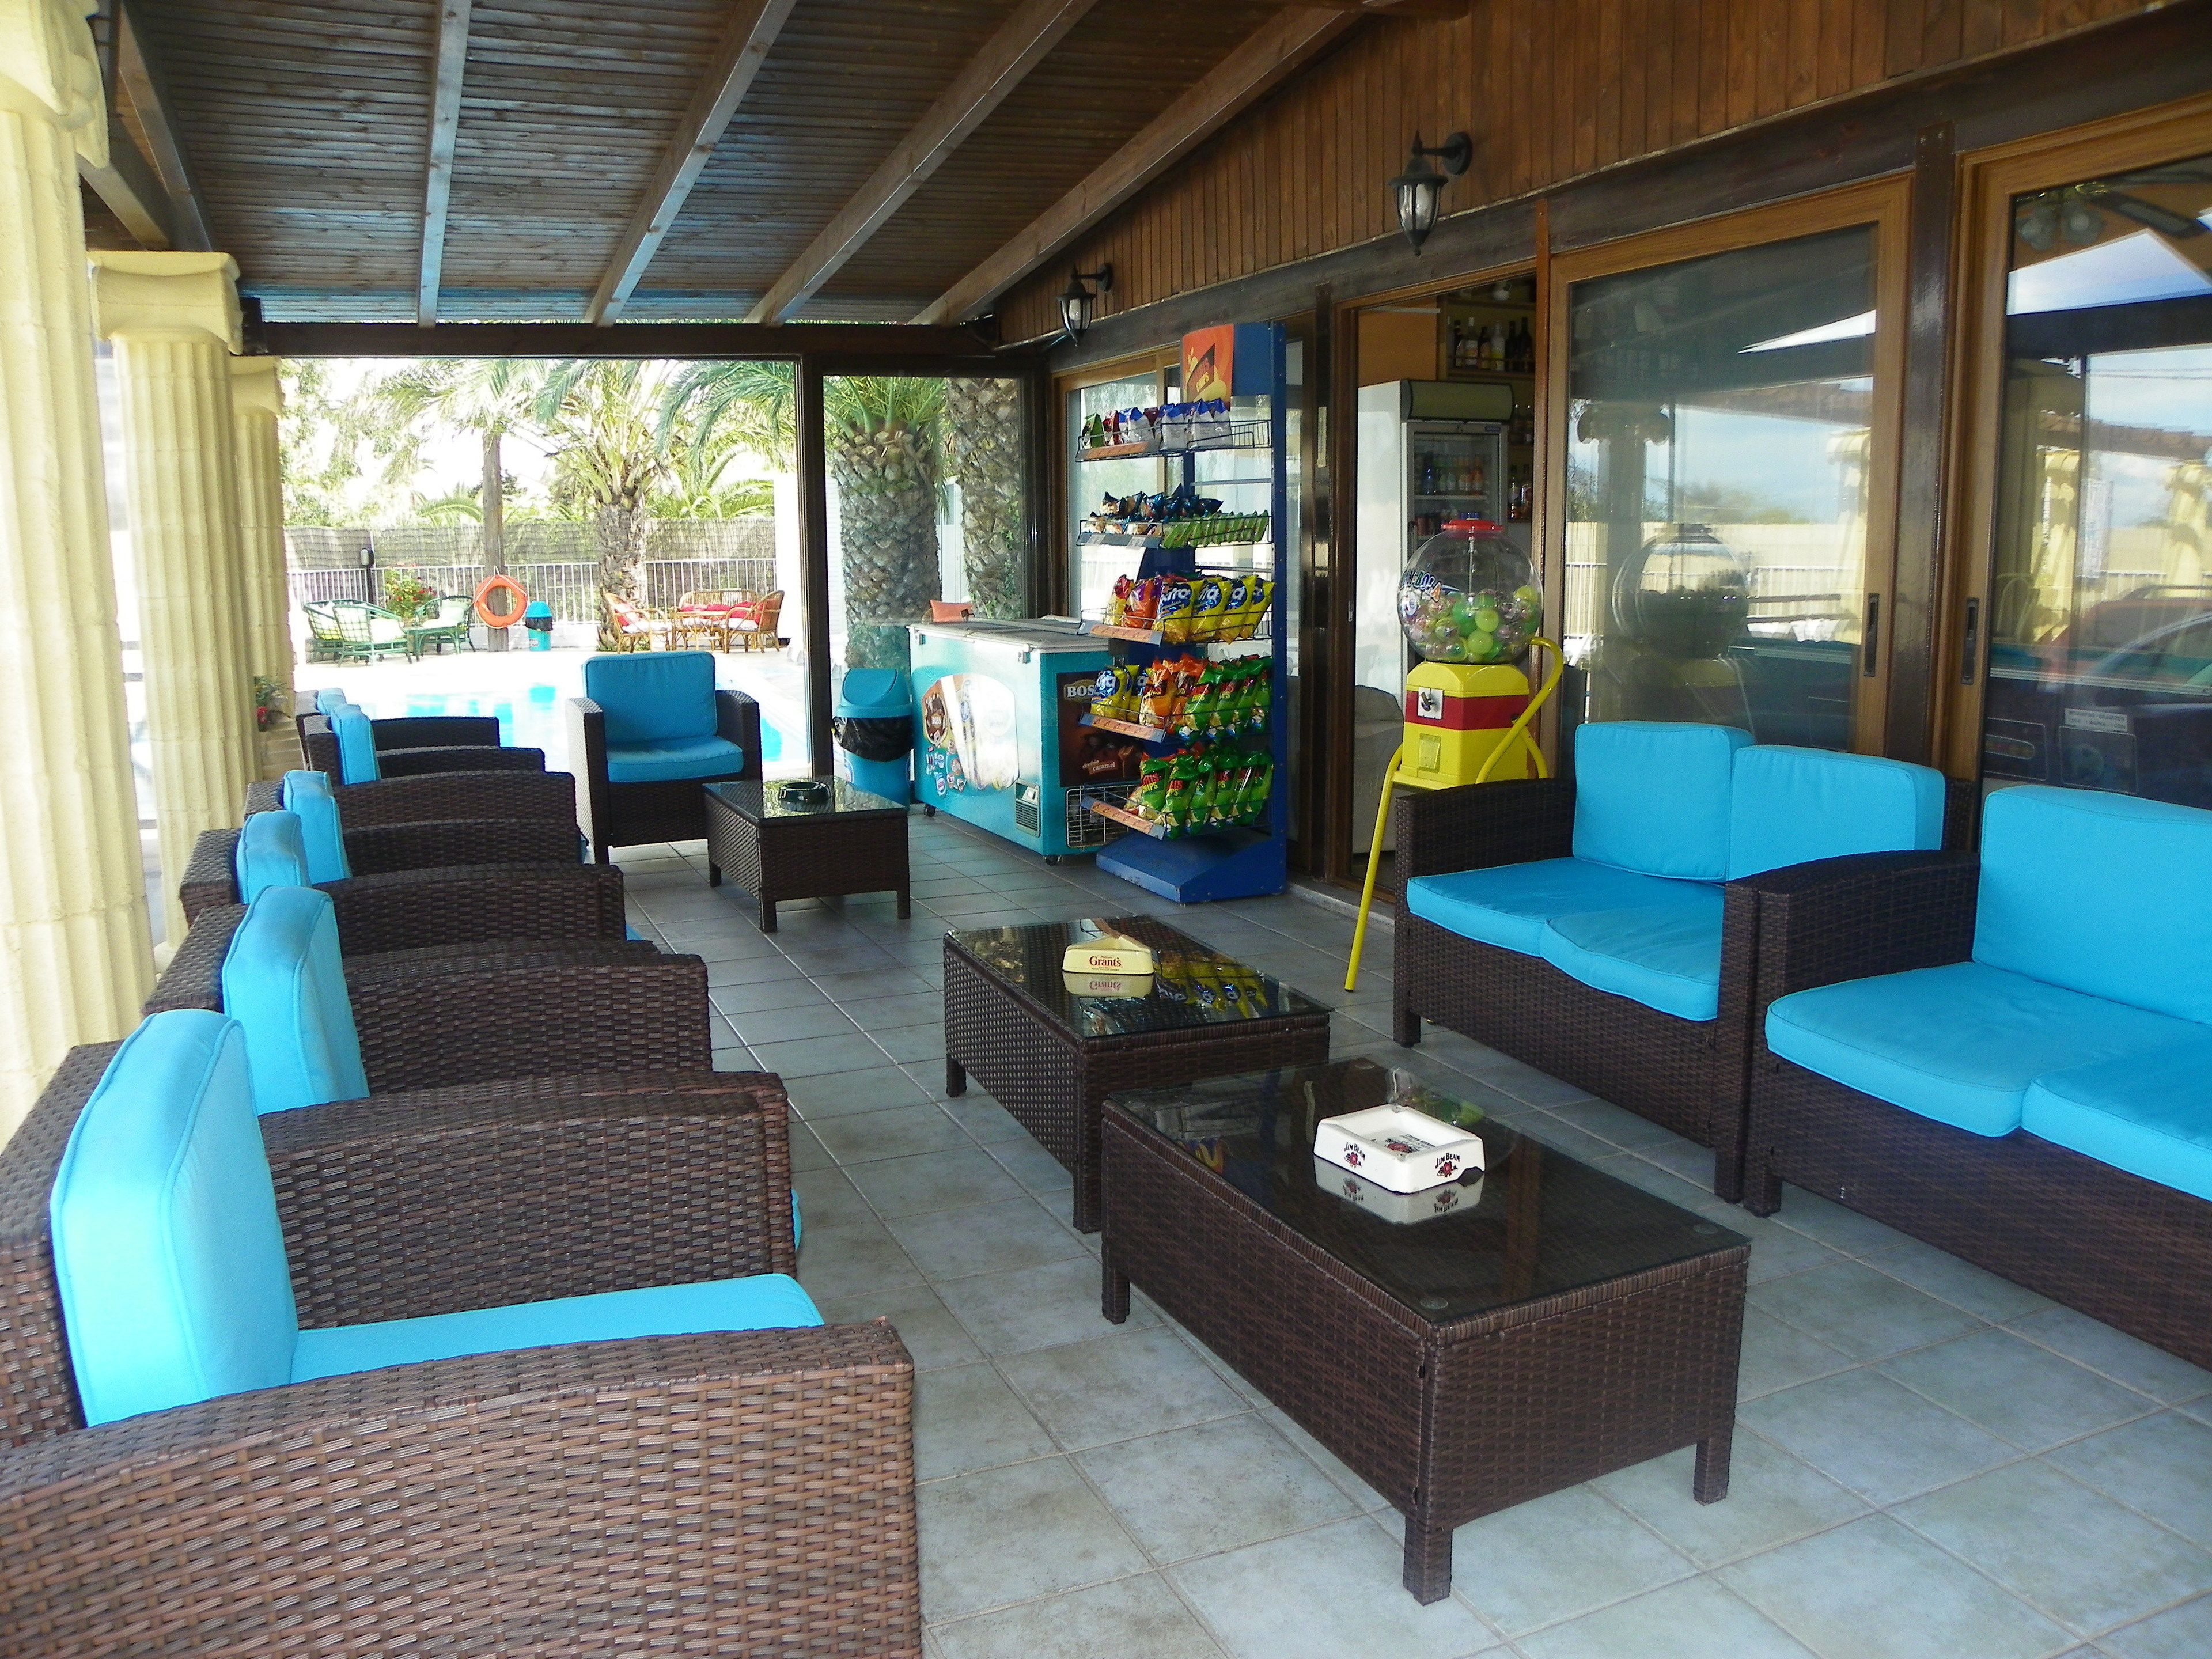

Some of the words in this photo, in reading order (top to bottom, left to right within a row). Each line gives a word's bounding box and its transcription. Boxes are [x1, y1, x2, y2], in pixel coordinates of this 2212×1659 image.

[1067, 684, 1099, 698] BOS
[1093, 762, 1115, 771] caramel
[1089, 956, 1122, 967] Grant's
[1343, 1142, 1354, 1152] JIM
[1354, 1143, 1366, 1161] BEAM
[1435, 1156, 1445, 1169] JIM
[1445, 1152, 1460, 1162] BEAM
